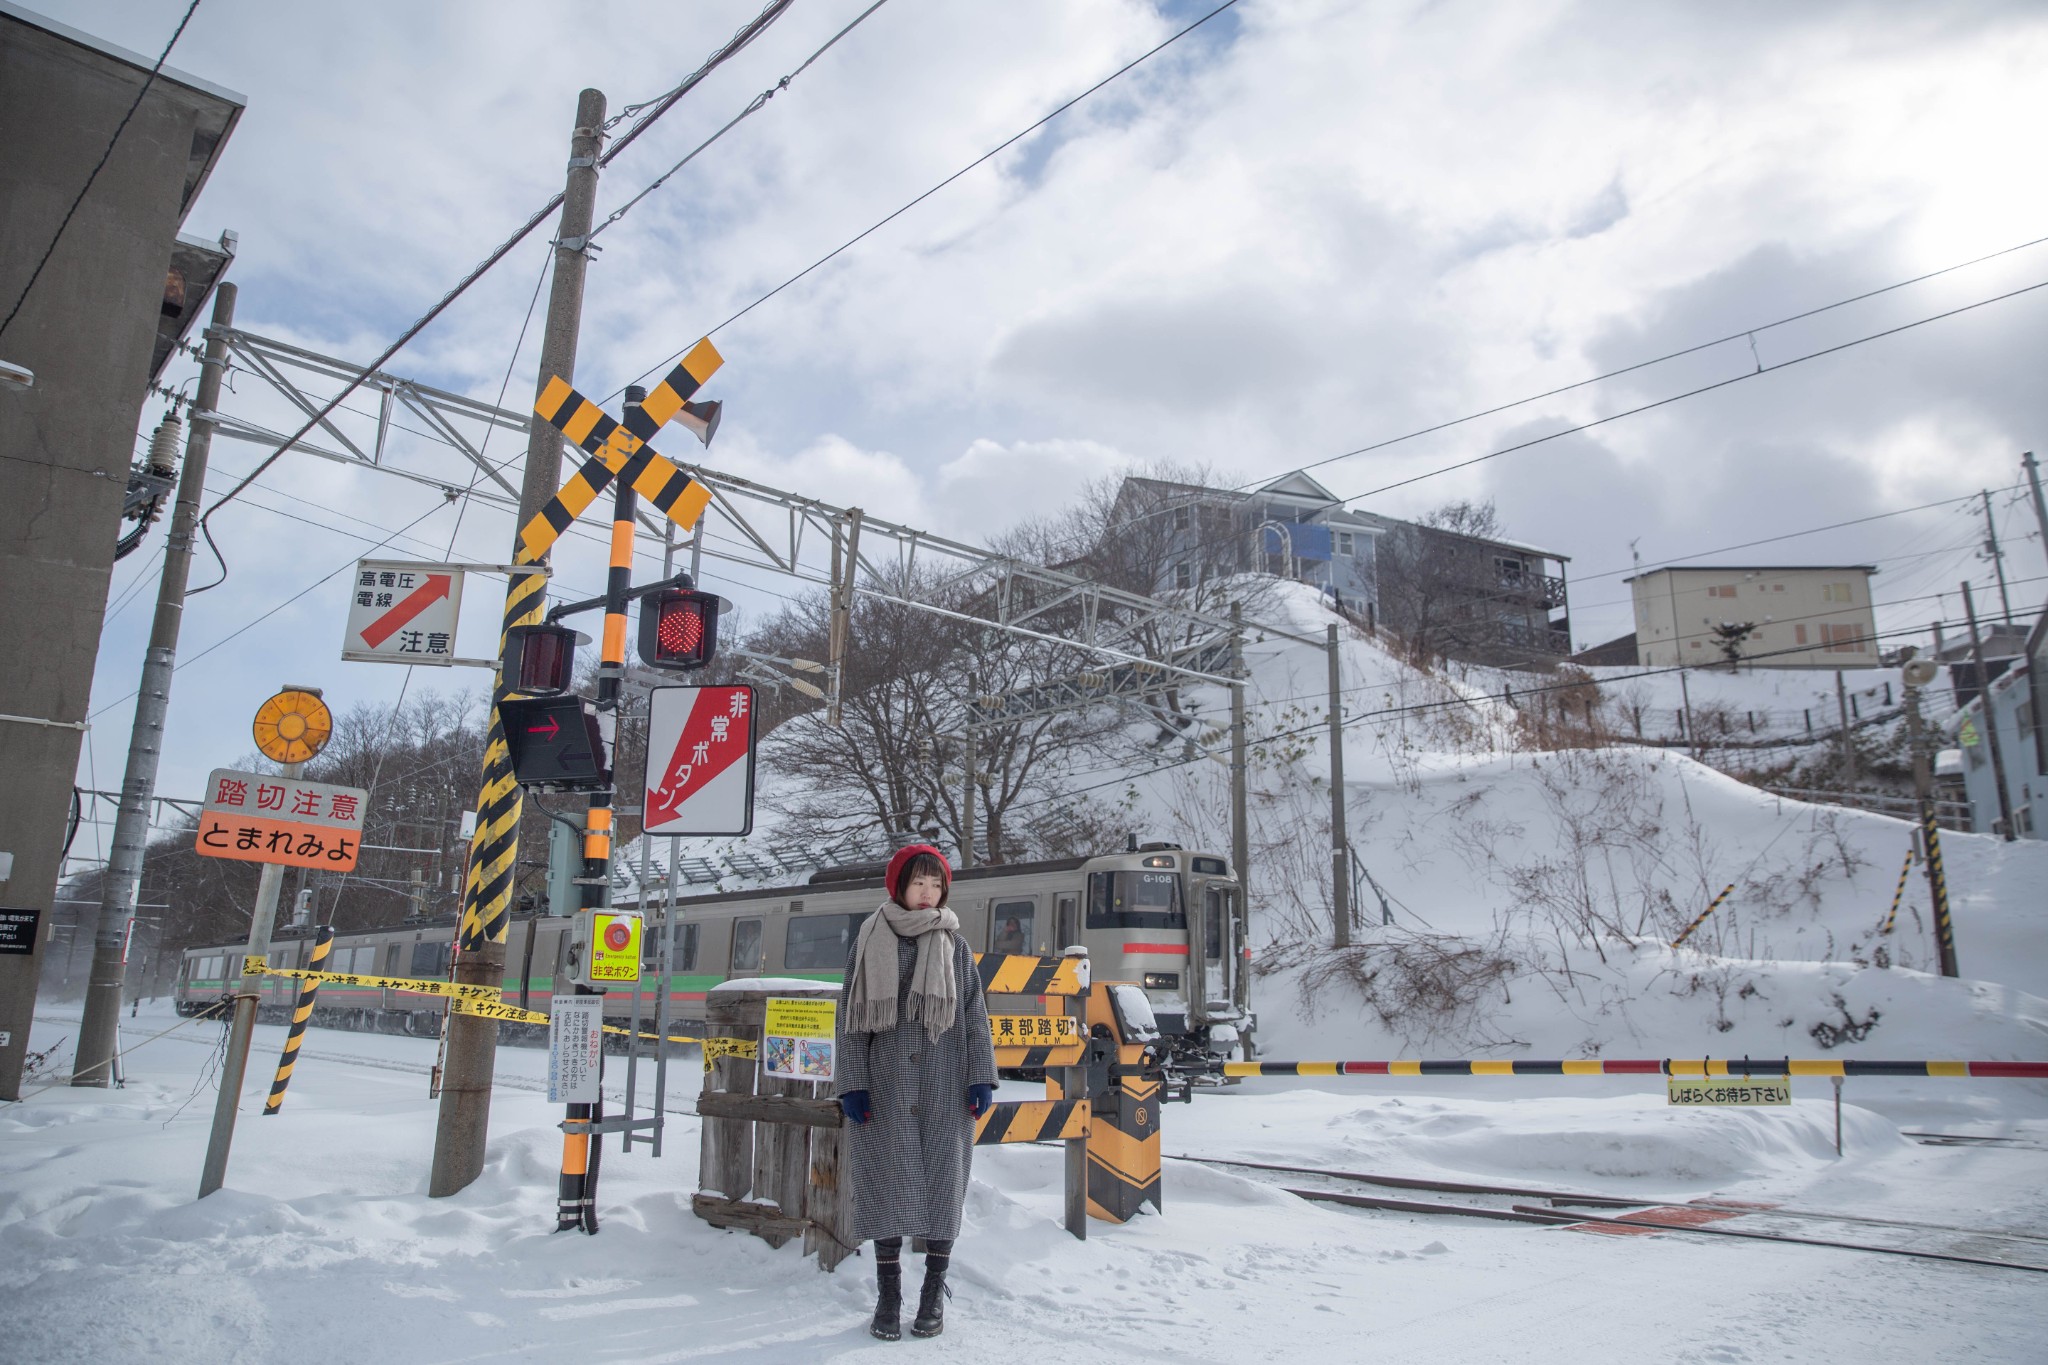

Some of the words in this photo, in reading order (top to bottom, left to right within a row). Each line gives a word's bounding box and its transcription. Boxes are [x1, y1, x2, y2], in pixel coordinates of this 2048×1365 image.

[359, 571, 416, 589] 高電圧
[357, 591, 393, 608] 電線
[399, 630, 451, 655] 注意
[658, 691, 749, 811] 非常ボタン
[215, 778, 359, 822] 踏切注意
[203, 822, 355, 862] とまれみよ
[1143, 874, 1173, 884] G-108
[593, 965, 637, 978] 非常ボタン
[475, 1001, 528, 1021] キケン注意
[588, 1030, 599, 1068] おねがい
[1669, 1086, 1789, 1104] しばらくお待ち下さい
